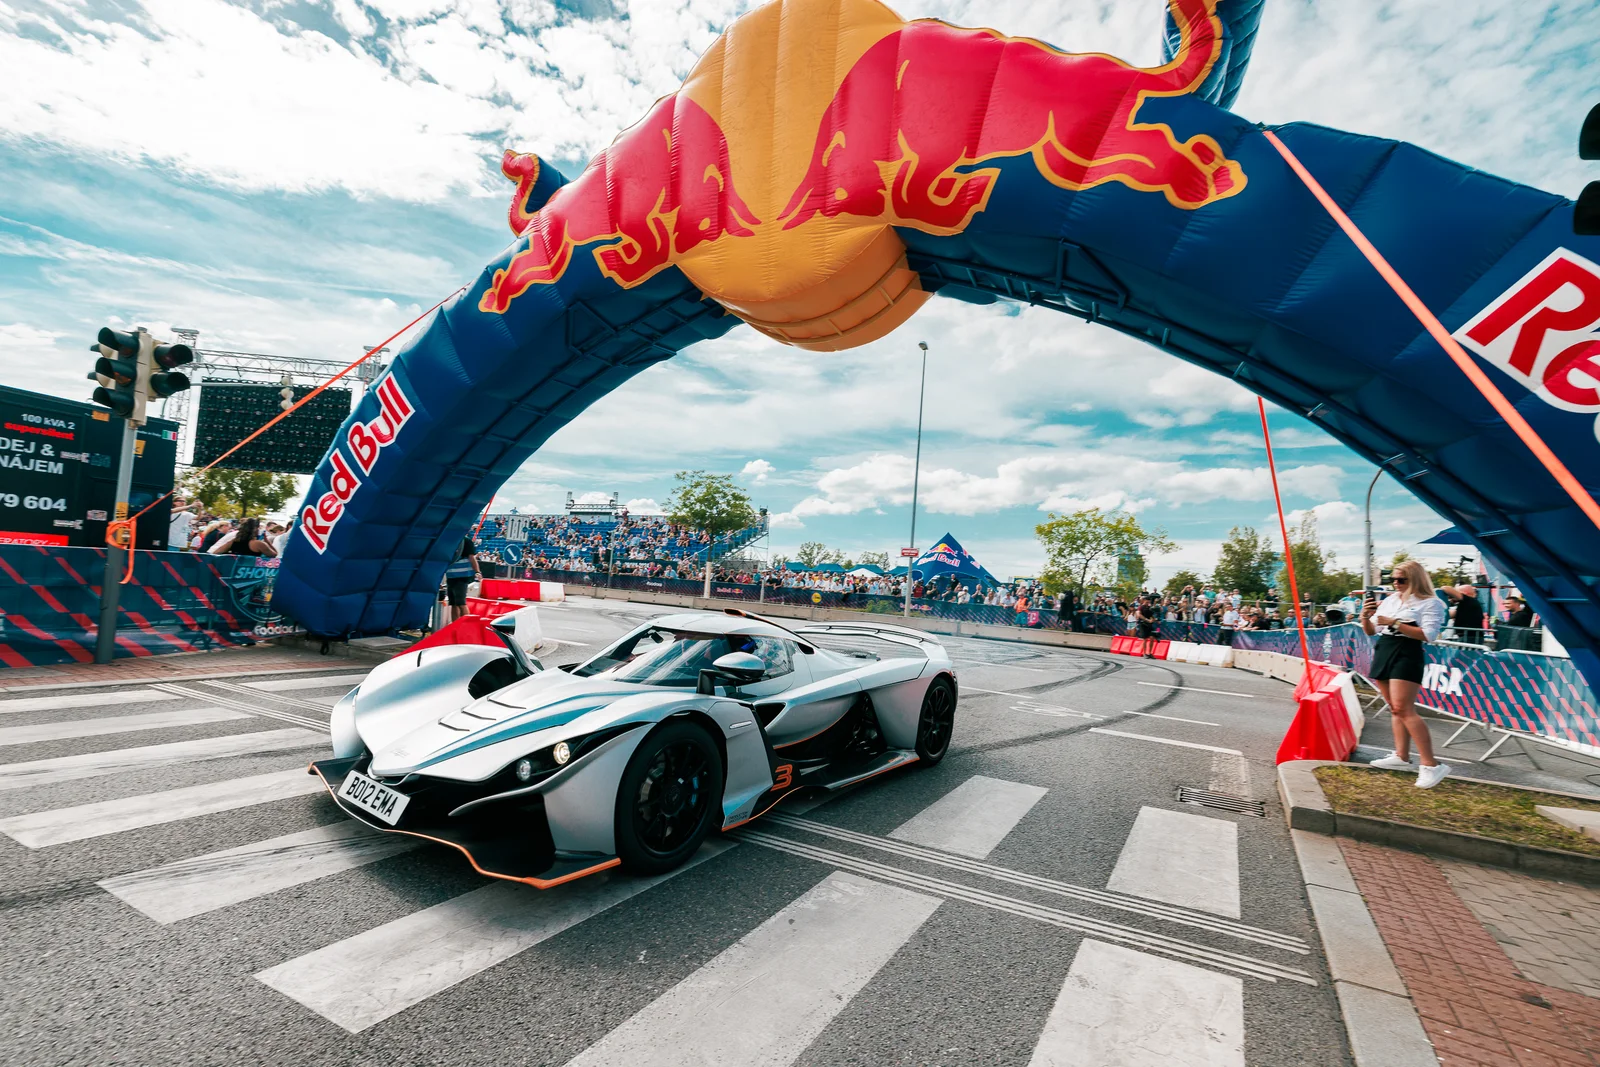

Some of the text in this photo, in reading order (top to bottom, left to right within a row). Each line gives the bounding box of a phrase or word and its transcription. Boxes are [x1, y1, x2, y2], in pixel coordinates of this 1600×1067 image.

[1452, 248, 1600, 413] Re
[40, 443, 55, 457] &
[300, 372, 414, 554] Red Bull
[23, 495, 67, 512] 604
[1421, 663, 1463, 697] VISA
[770, 763, 793, 791] 3
[370, 788, 398, 817] EMA
